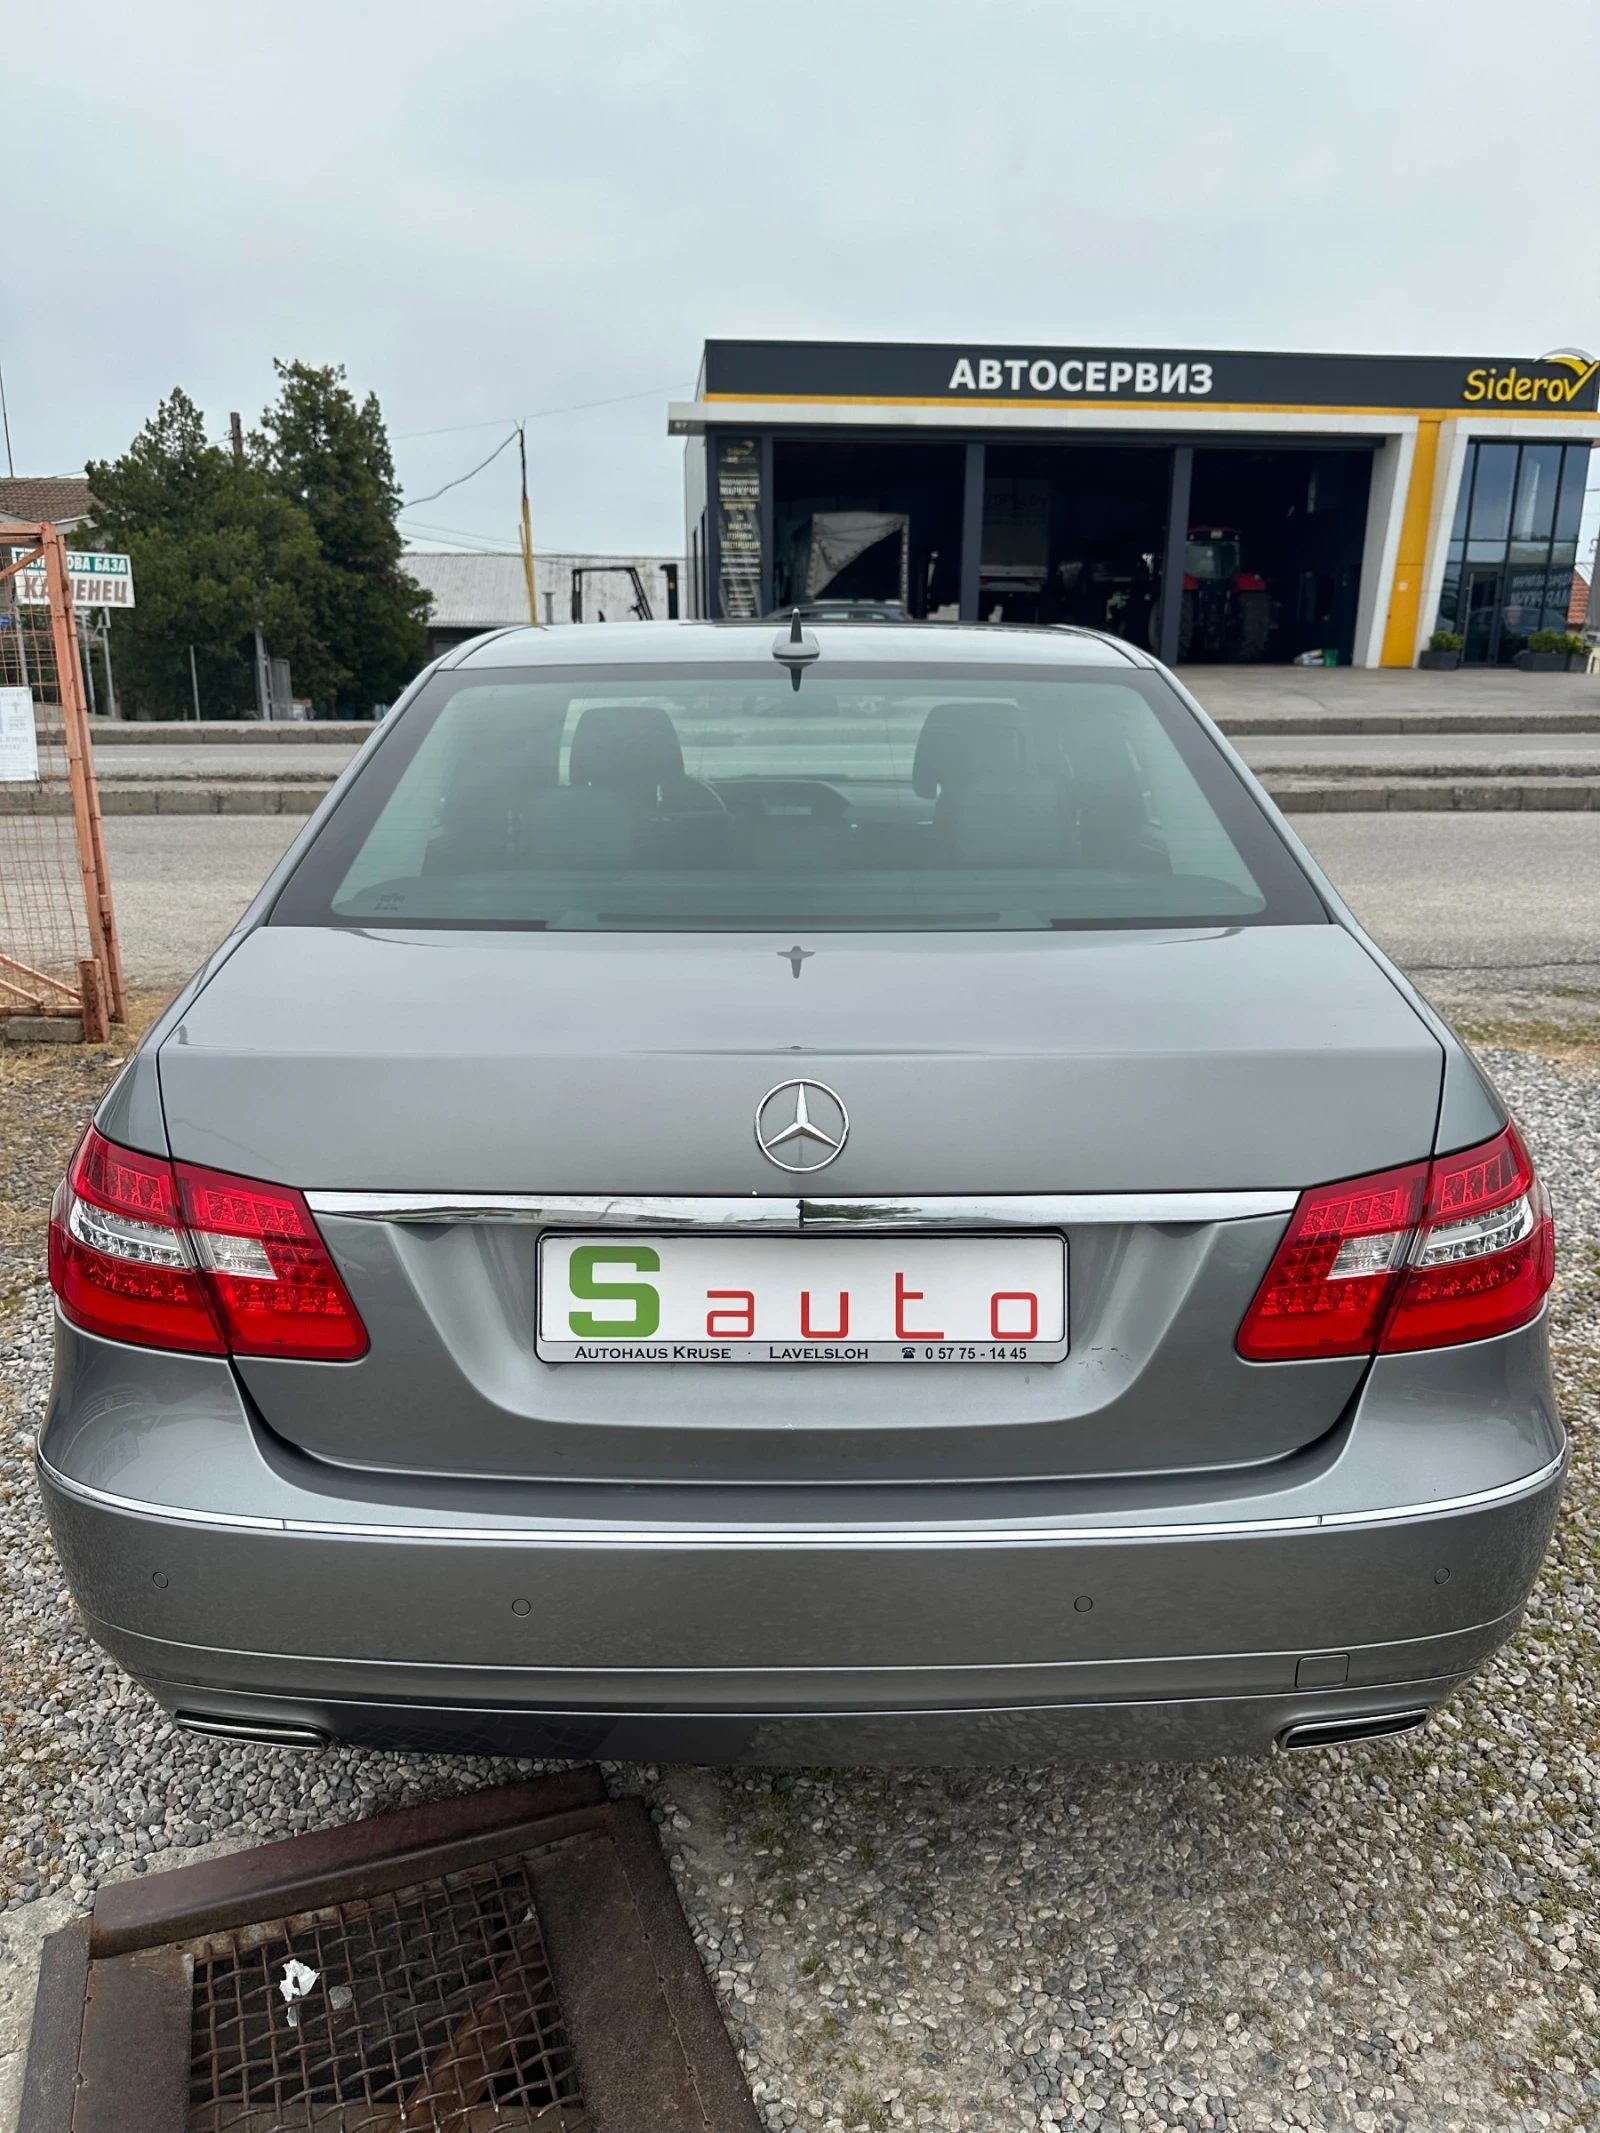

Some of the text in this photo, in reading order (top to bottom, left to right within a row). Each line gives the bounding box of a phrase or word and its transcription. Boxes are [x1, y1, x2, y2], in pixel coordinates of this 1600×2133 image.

[948, 358, 1213, 394] АВТОСЕРВИЗ
[1463, 360, 1600, 402] Siderov
[94, 559, 127, 573] БАЗА
[24, 577, 127, 604] КАЕНЕЦ
[574, 1345, 668, 1359] AUTOHAUS
[673, 1346, 731, 1359] KRUSE
[769, 1346, 869, 1359] LAVELSLOH
